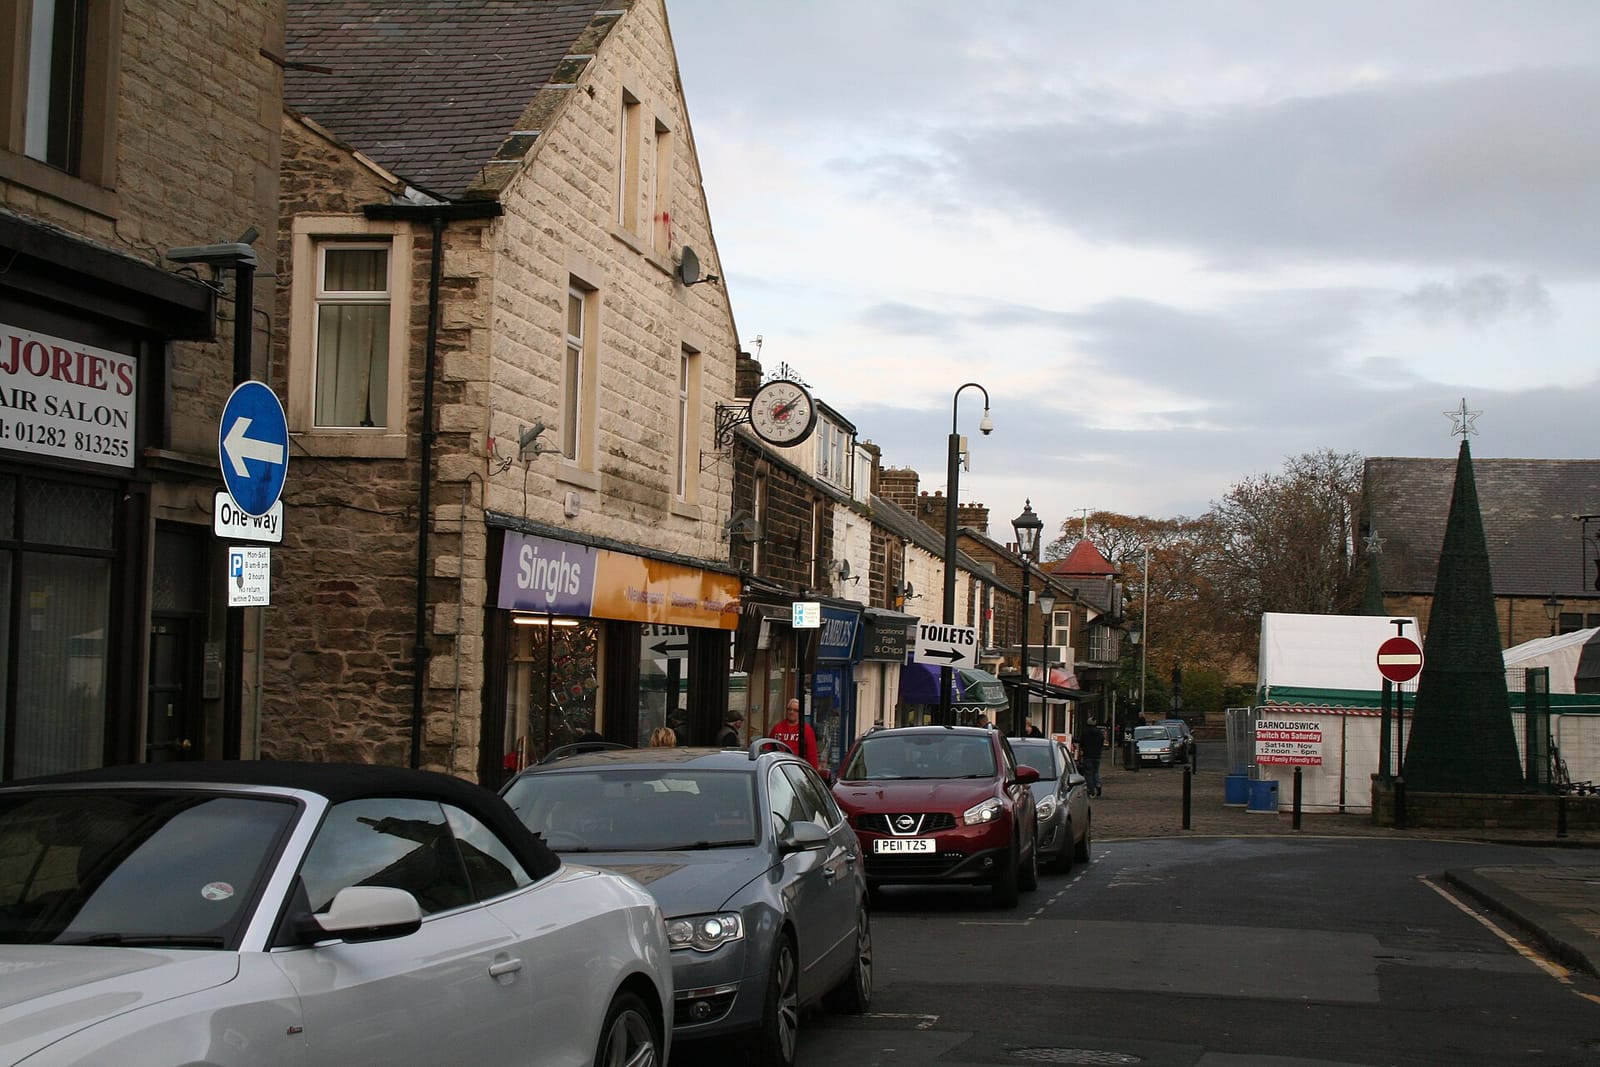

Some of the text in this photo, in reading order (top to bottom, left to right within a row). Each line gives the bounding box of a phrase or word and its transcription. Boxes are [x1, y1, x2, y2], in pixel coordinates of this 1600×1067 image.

[0, 335, 133, 396] JORIE'S
[44, 394, 129, 429] SALON
[15, 420, 66, 448] 01282
[74, 432, 129, 458] 813255
[221, 503, 278, 534] One way
[248, 572, 252, 580] 2
[517, 544, 581, 603] Singhs
[920, 624, 974, 646] TOILETS
[874, 645, 904, 656] & Chips
[1257, 721, 1320, 731] BARNOLDSWICK
[1256, 731, 1279, 740] Switch
[1291, 732, 1321, 742] Saturday
[1271, 756, 1289, 764] Family
[882, 840, 927, 851] PE11 TZS
